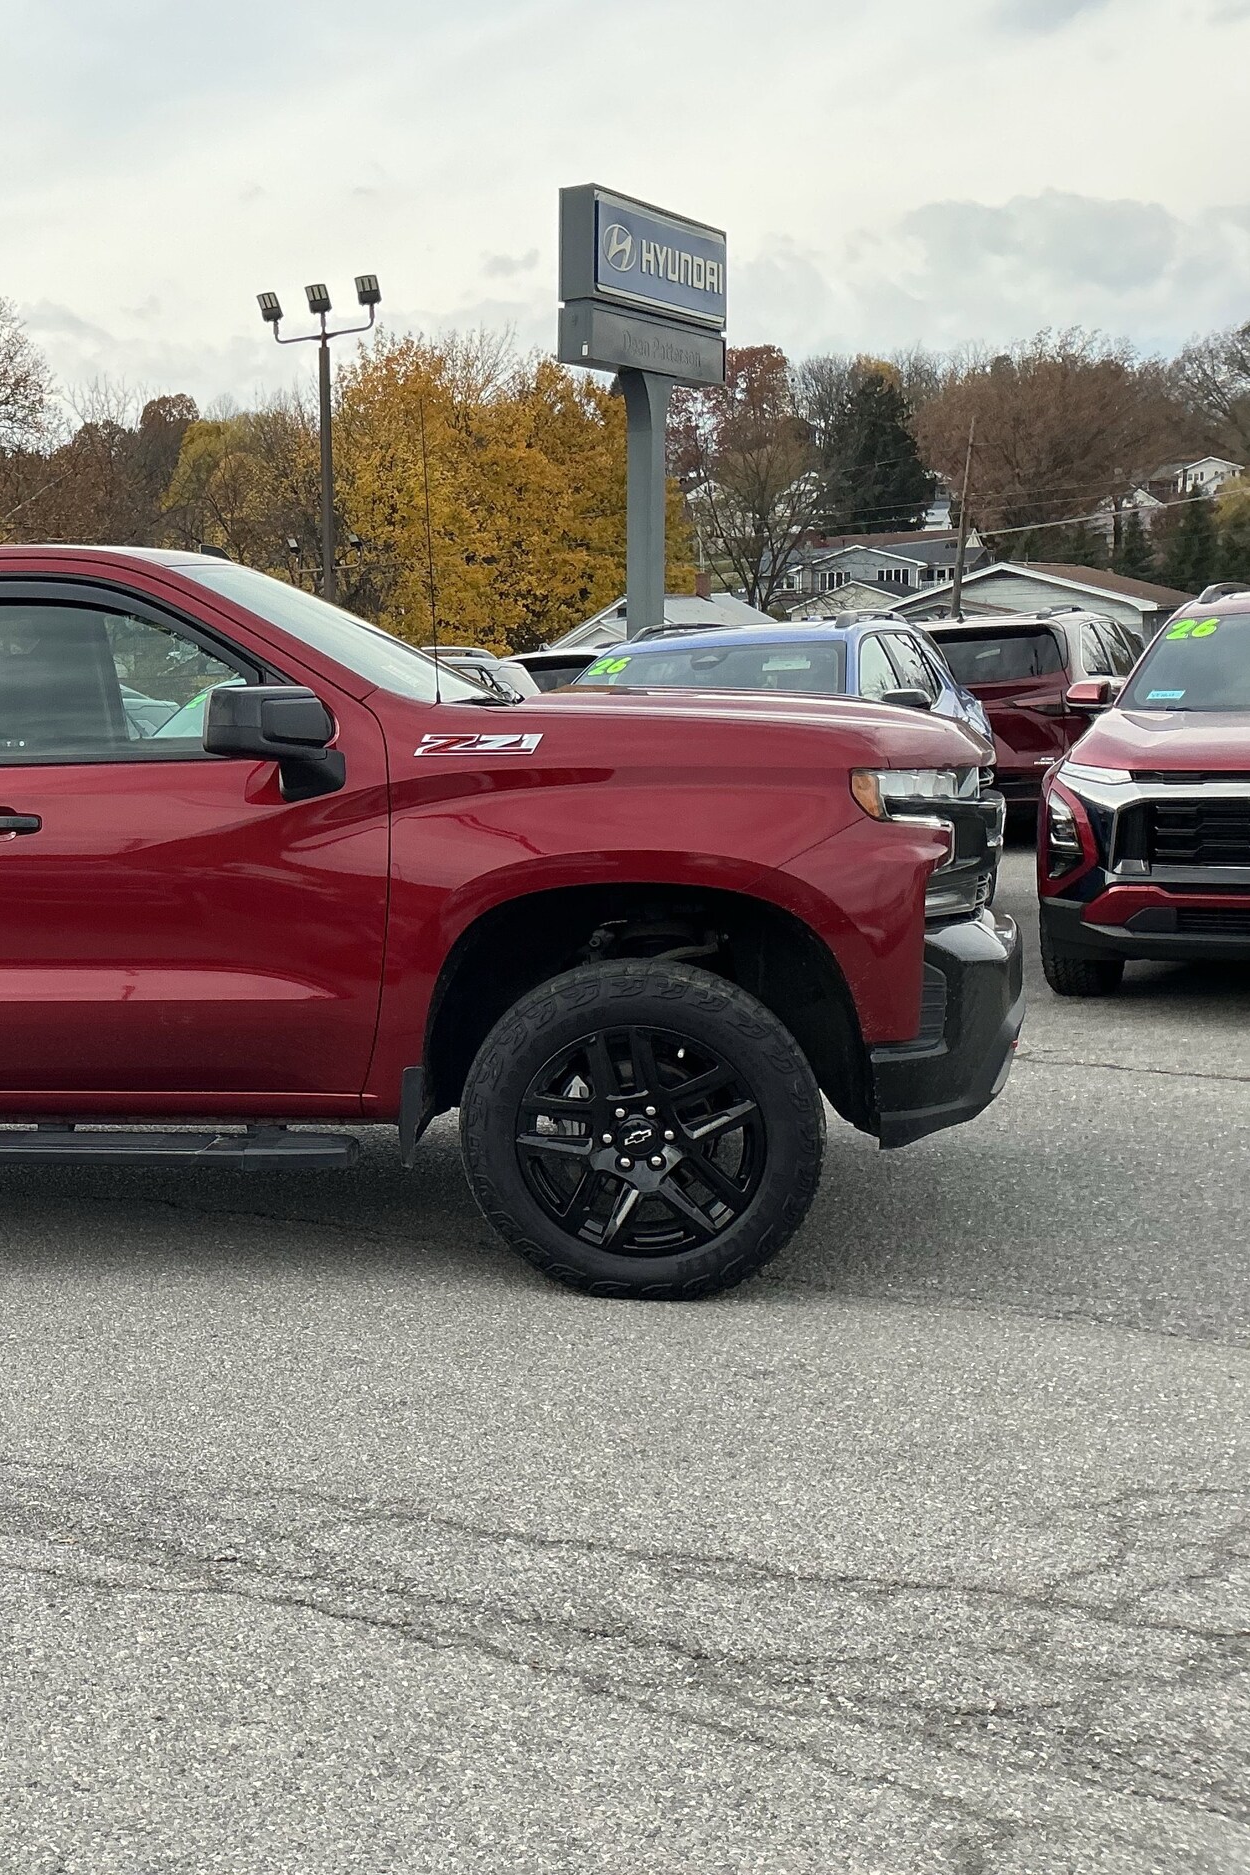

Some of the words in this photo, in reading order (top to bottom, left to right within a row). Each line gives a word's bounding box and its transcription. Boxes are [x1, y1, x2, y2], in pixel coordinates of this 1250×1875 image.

[641, 239, 723, 295] HYUNDAI
[623, 330, 650, 357] Dean
[653, 336, 701, 368] Patterson
[1166, 617, 1221, 639] 26
[588, 656, 632, 676] 26
[413, 733, 544, 757] Z71
